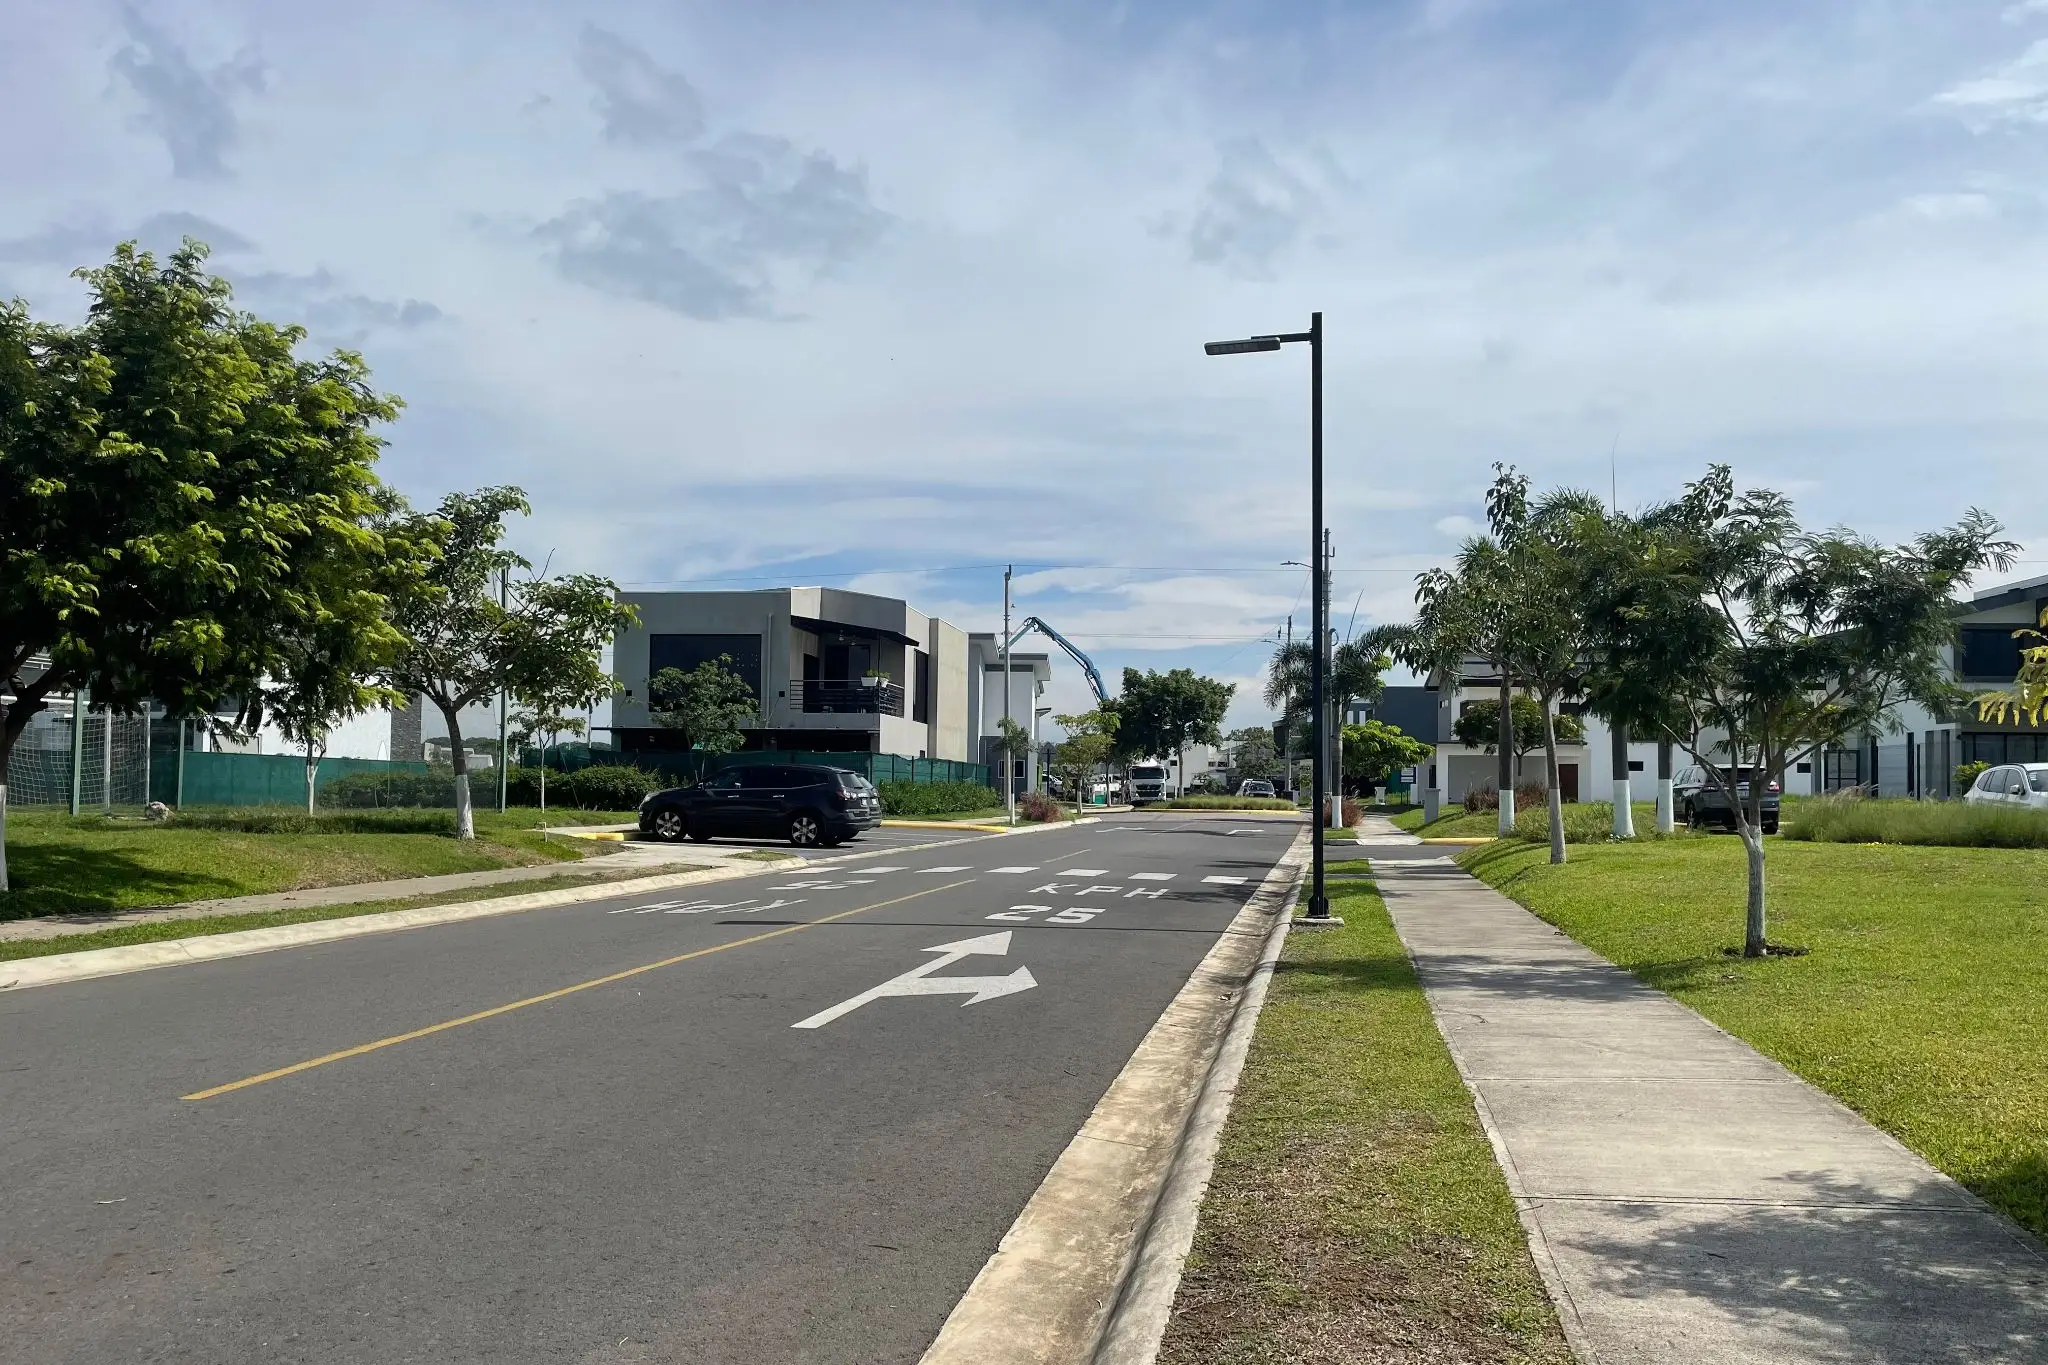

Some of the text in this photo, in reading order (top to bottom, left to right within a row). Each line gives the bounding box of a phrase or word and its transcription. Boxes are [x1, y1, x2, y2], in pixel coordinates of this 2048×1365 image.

[766, 880, 877, 890] 25
[1027, 882, 1170, 899] KPH
[607, 899, 808, 914] KPH
[984, 904, 1107, 924] 25
